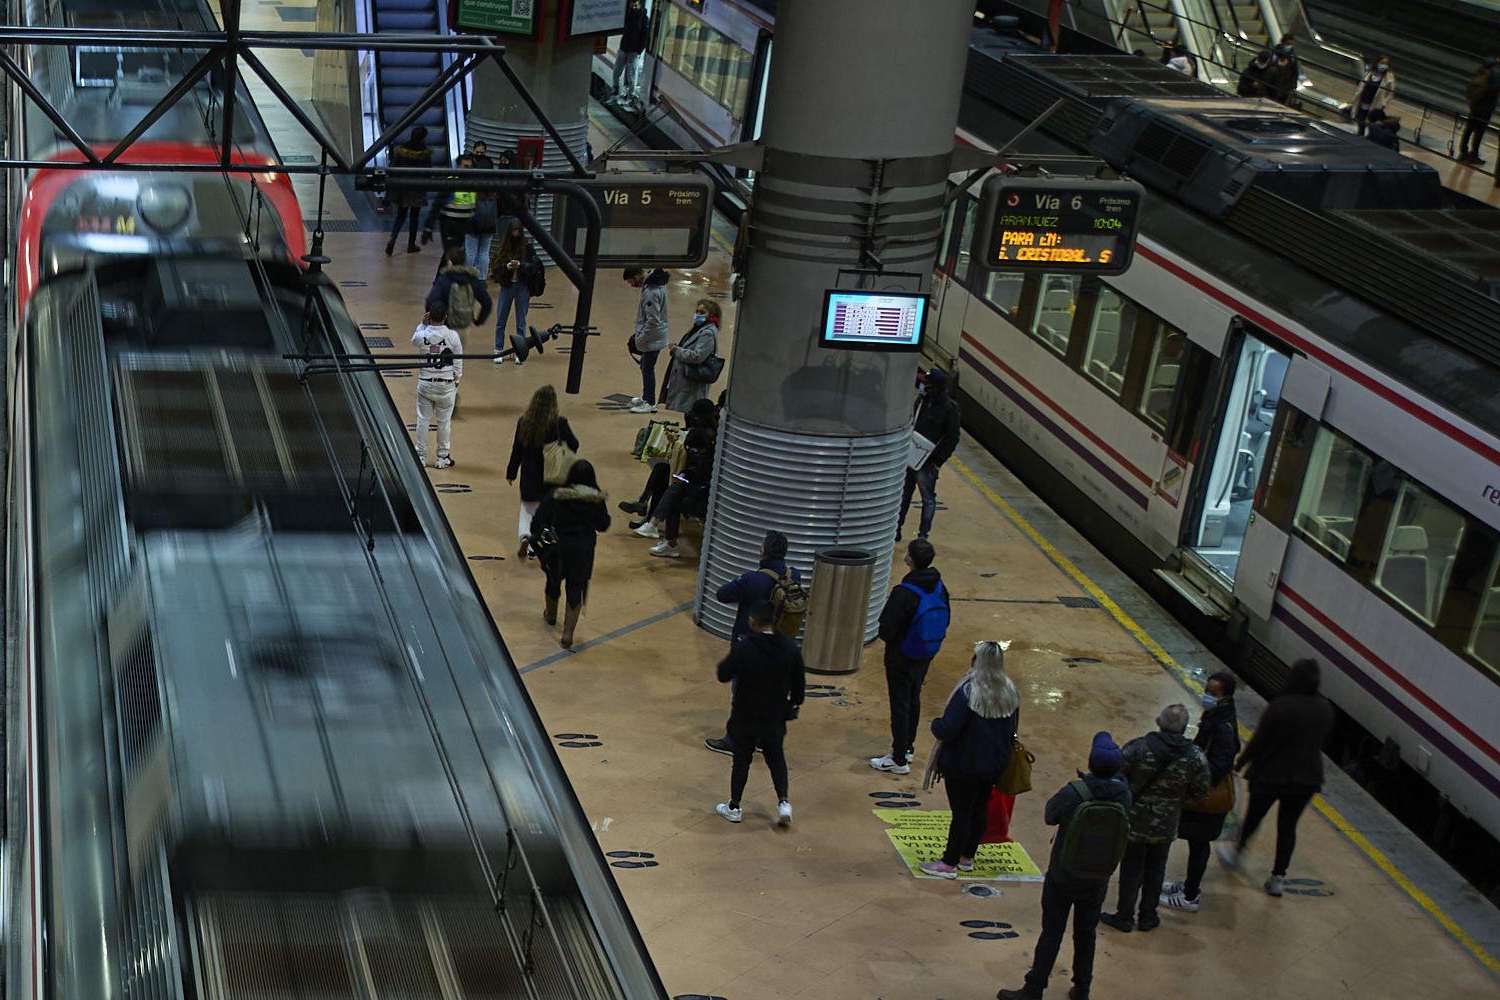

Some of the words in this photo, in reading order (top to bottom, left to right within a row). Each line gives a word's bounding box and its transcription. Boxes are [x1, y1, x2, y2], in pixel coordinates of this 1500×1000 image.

[603, 190, 629, 205] Vía
[641, 190, 652, 205] 5
[1034, 194, 1060, 210] Vía
[1070, 195, 1083, 210] 6
[1105, 205, 1122, 213] tren
[1000, 215, 1059, 228] ARANJUEZ
[1093, 218, 1123, 229] 10:04
[1002, 231, 1034, 246] PARA
[1039, 232, 1062, 247] EN:
